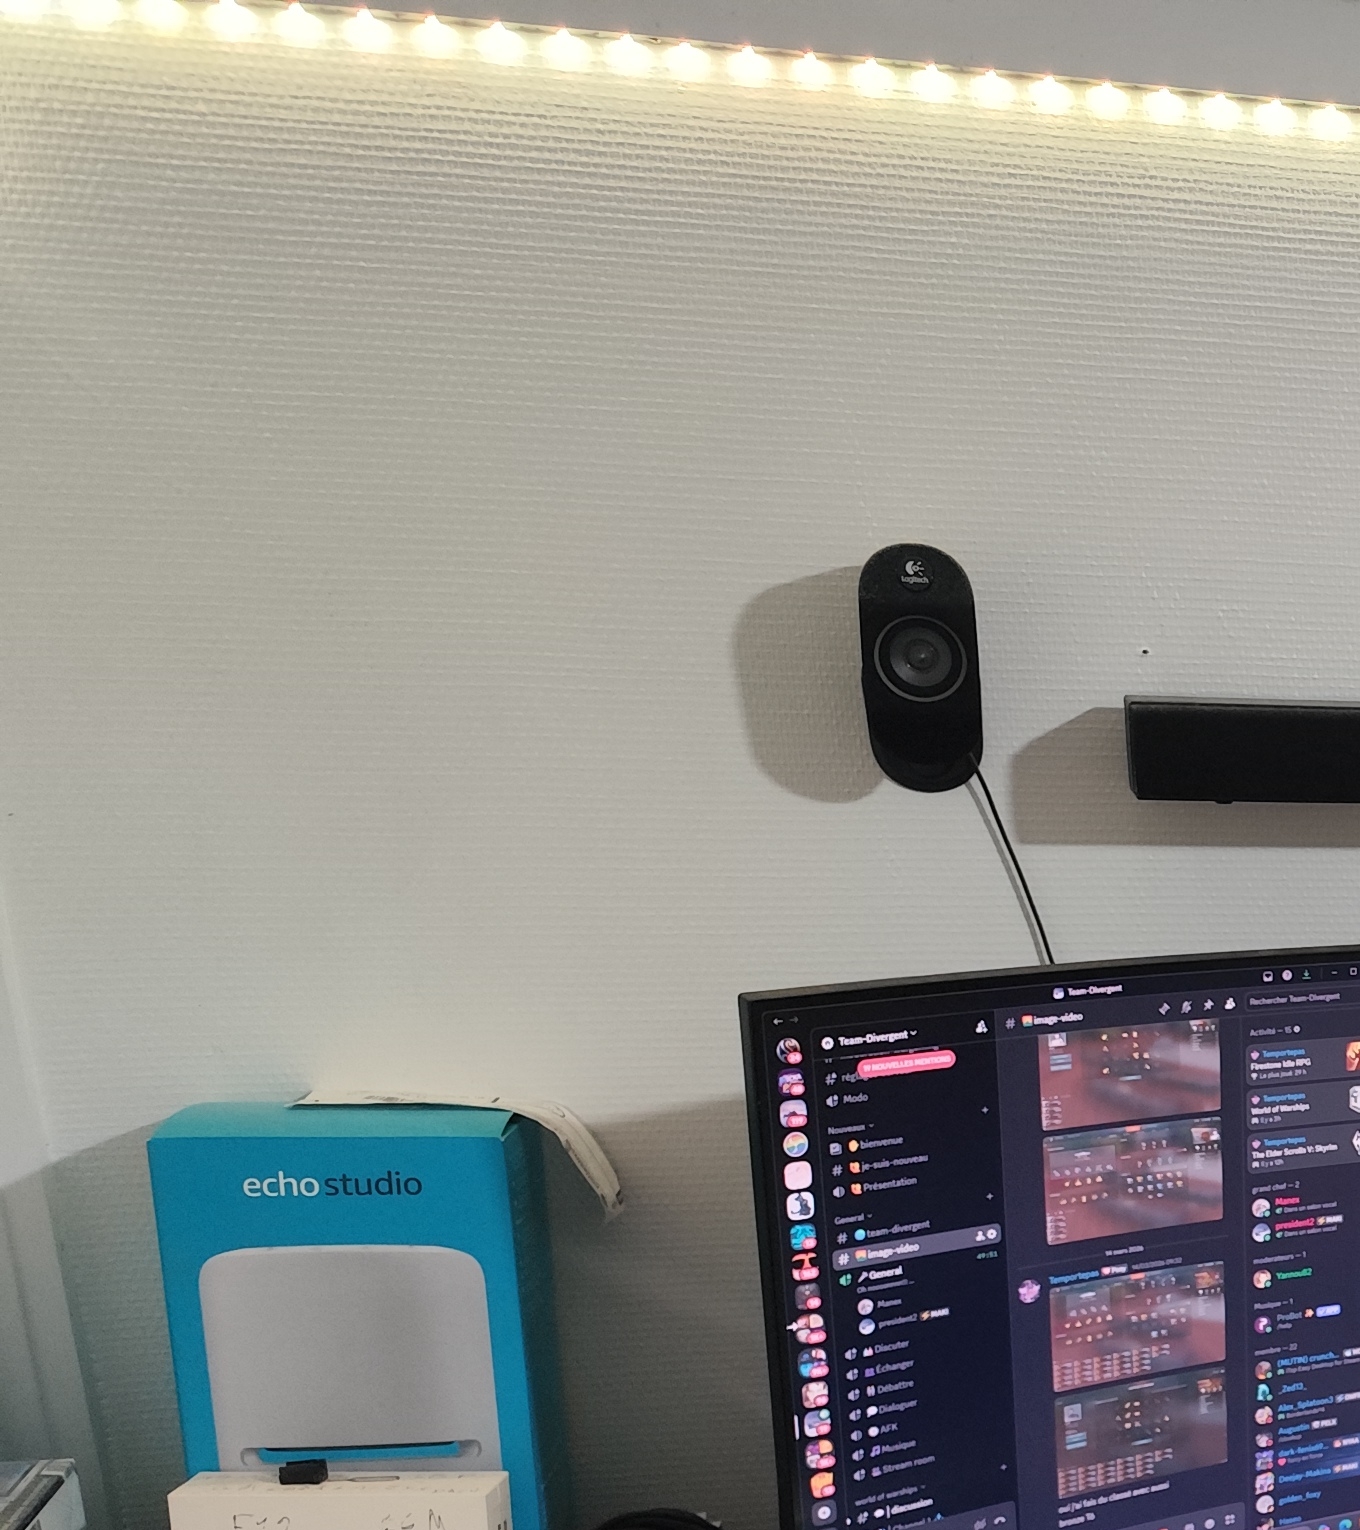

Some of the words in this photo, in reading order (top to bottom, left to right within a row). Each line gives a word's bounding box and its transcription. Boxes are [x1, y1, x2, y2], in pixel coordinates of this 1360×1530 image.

[838, 1030, 908, 1047] Team-Divergent
[843, 1093, 868, 1104] Modo
[860, 1137, 903, 1149] bienvenue
[862, 1155, 928, 1172] je-suis-nouveau
[243, 1171, 320, 1197] echo
[324, 1170, 422, 1196] studio
[864, 1177, 917, 1192] Présentation
[867, 1220, 930, 1237] team-divergent
[867, 1243, 919, 1259] image-video
[869, 1265, 903, 1280] General
[880, 1422, 898, 1434] AFK
